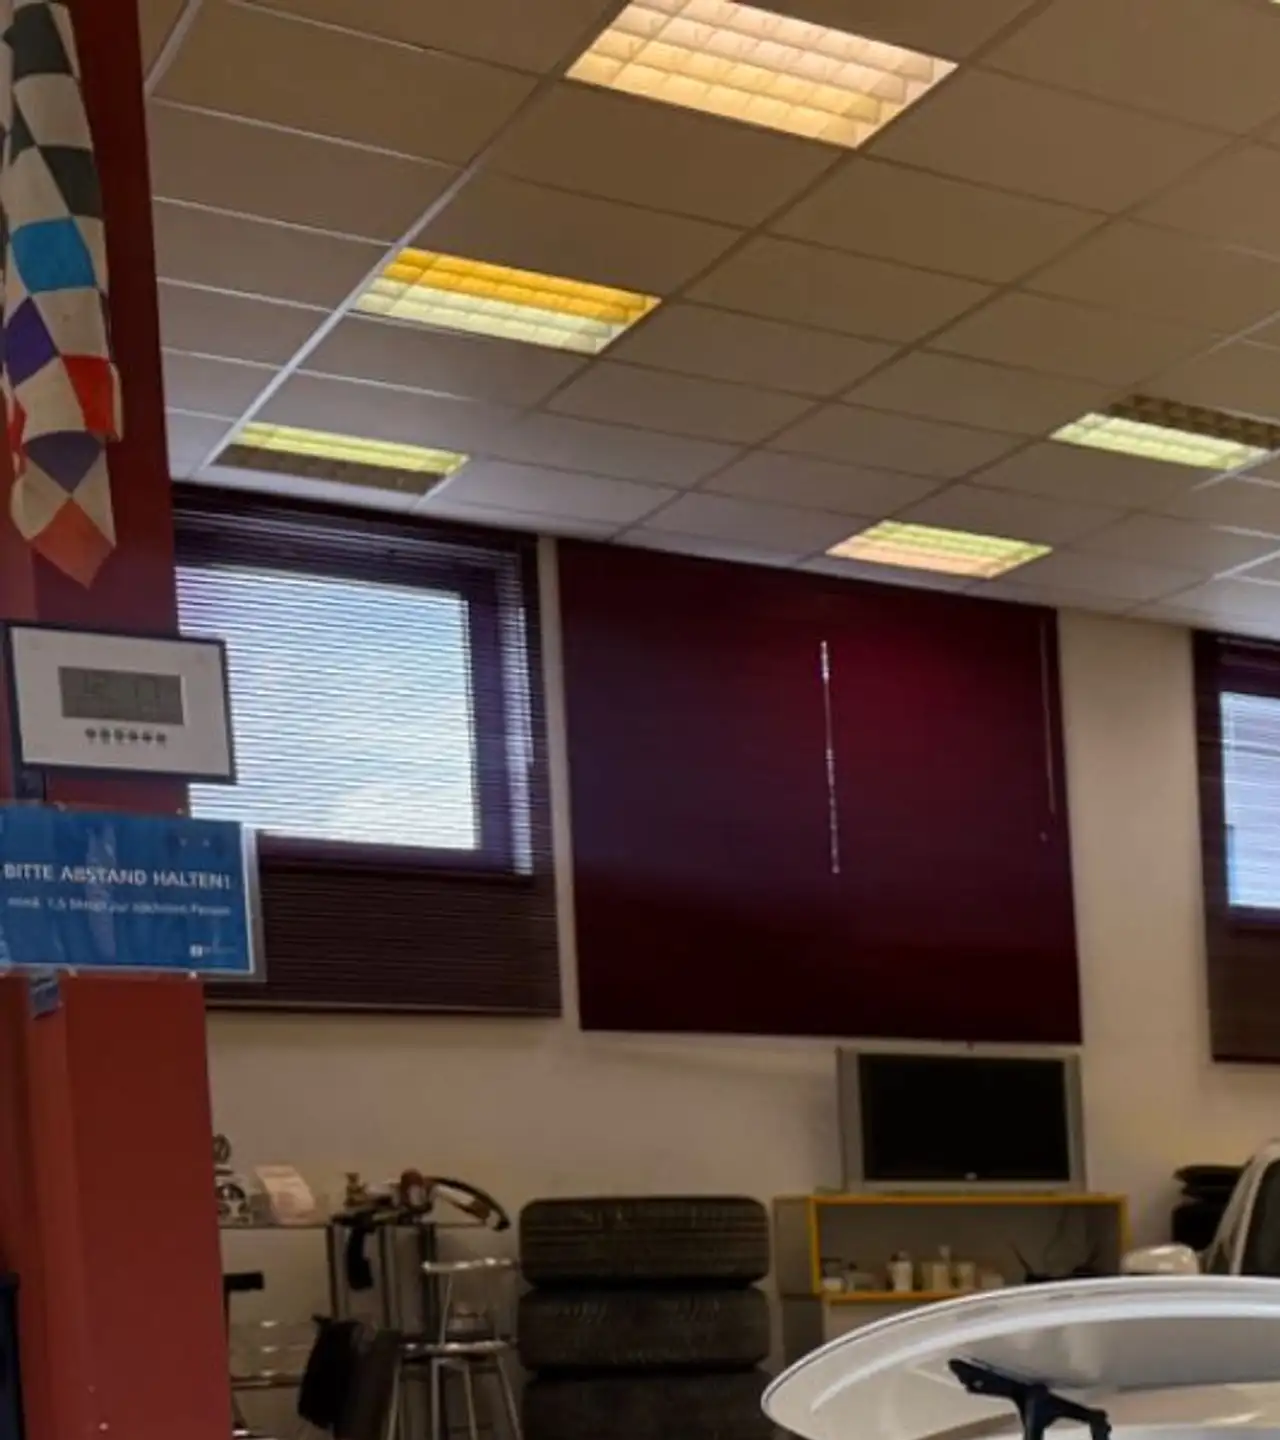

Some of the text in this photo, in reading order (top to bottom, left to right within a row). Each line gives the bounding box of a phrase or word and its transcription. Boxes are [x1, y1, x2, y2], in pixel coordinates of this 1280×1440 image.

[4, 863, 231, 891] BITTE ABSTAND HALTEN!
